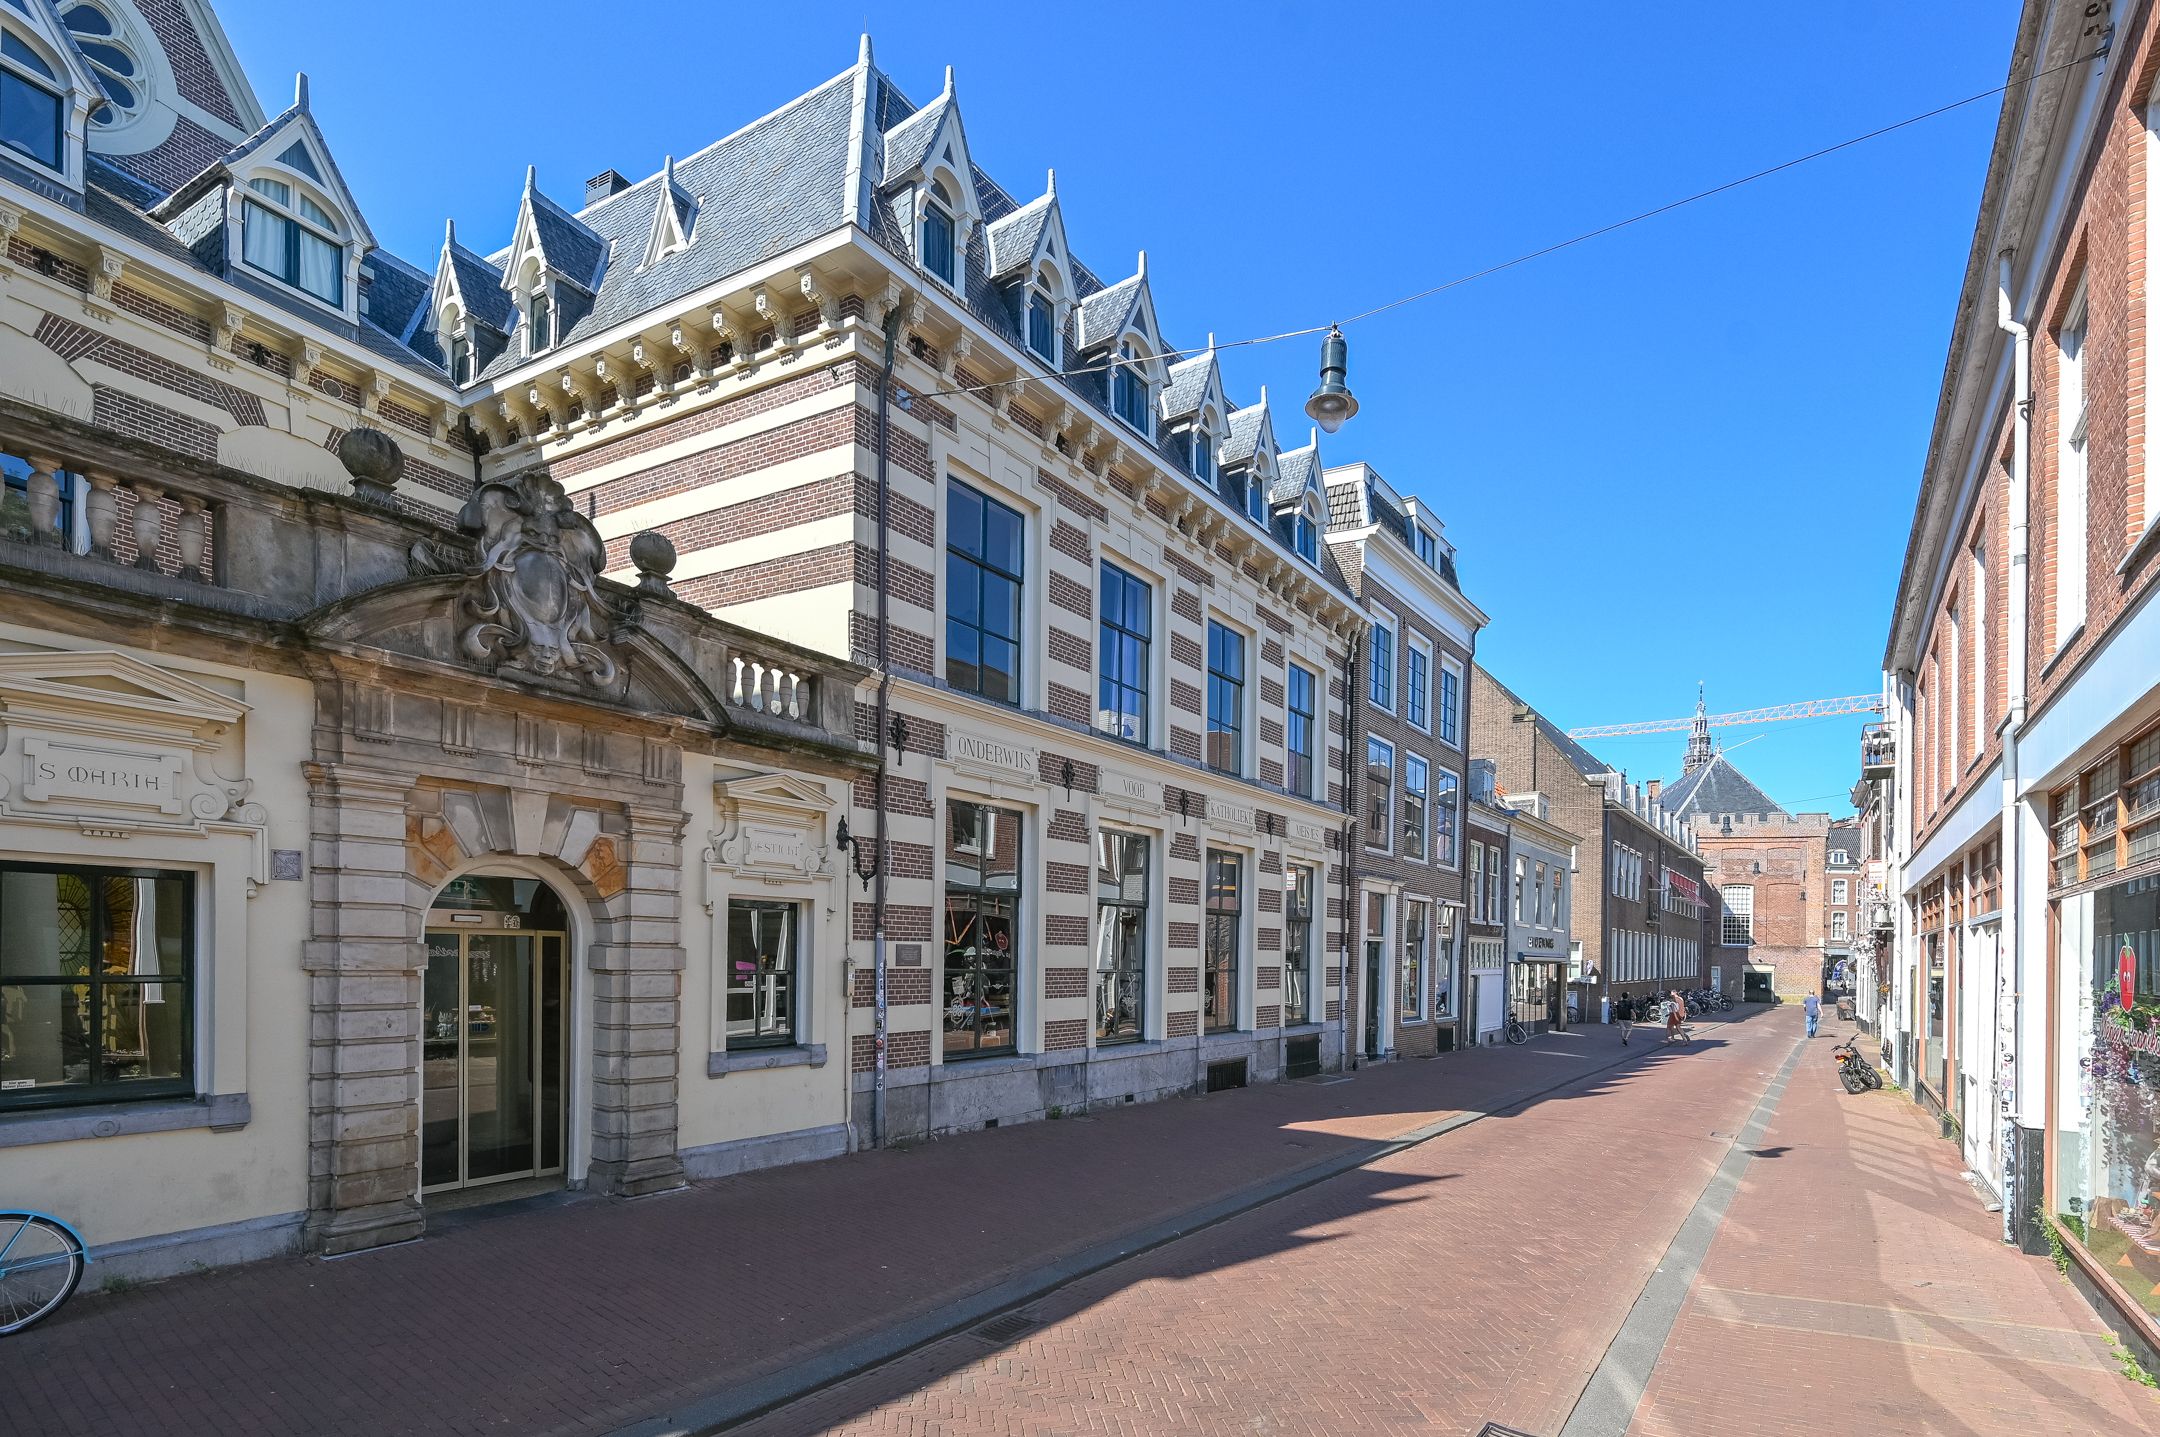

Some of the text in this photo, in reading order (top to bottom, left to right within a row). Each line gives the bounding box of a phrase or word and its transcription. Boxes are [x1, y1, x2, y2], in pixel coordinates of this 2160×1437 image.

[39, 762, 159, 791] S MARIA
[958, 736, 1031, 771] ONDERWIJS
[1122, 778, 1145, 799] VOOR
[1210, 802, 1254, 825] KATHOLIEKE
